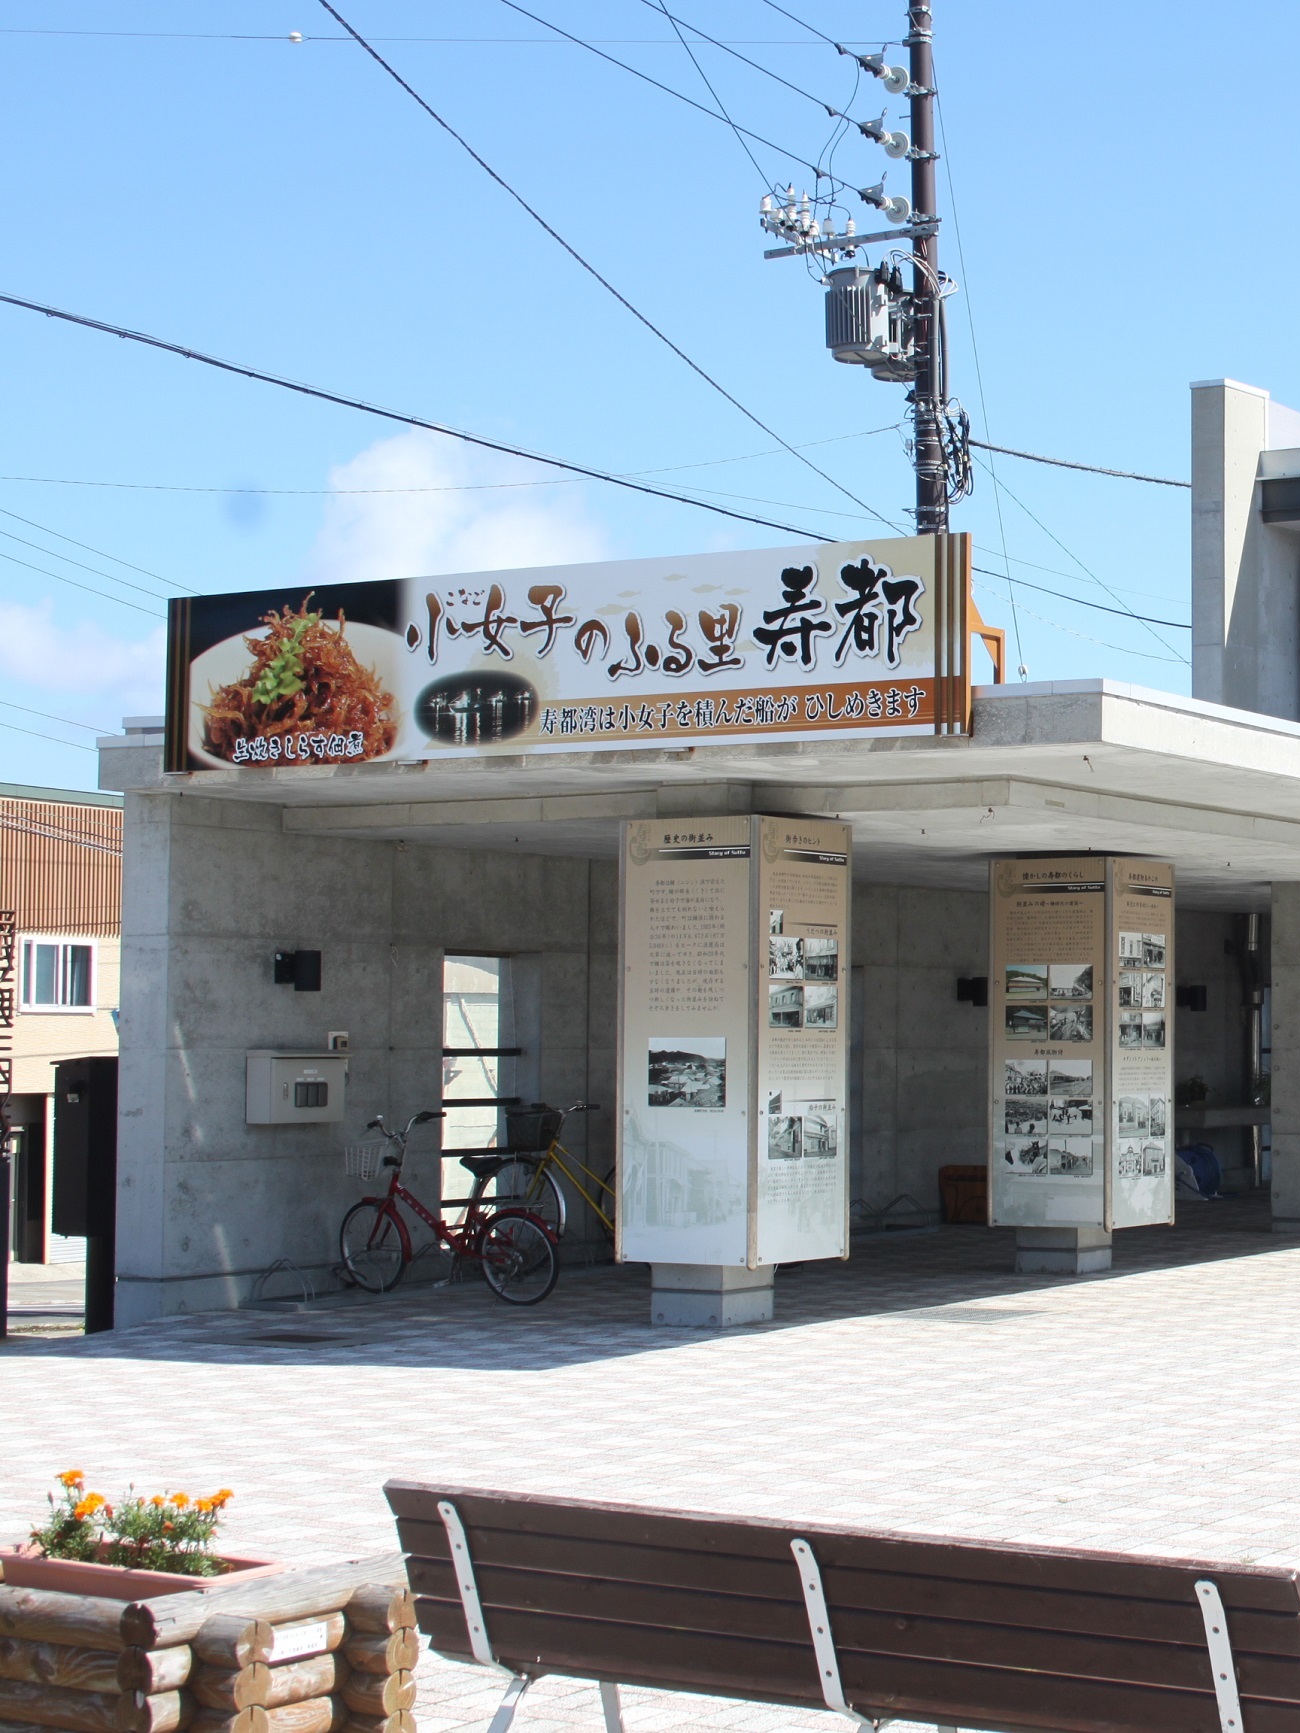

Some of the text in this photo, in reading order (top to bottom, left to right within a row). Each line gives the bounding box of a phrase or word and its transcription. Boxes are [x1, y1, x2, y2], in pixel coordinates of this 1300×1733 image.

[446, 588, 485, 607] こなご
[752, 556, 923, 670] 寿都
[805, 685, 927, 722] ひしめきます
[232, 730, 364, 763] 生炊きしらす佃煮
[663, 833, 714, 844] 歴史の街並み
[785, 834, 821, 846] 街歩きのヒント
[1021, 871, 1084, 881] 懐かしの寿都のくらし
